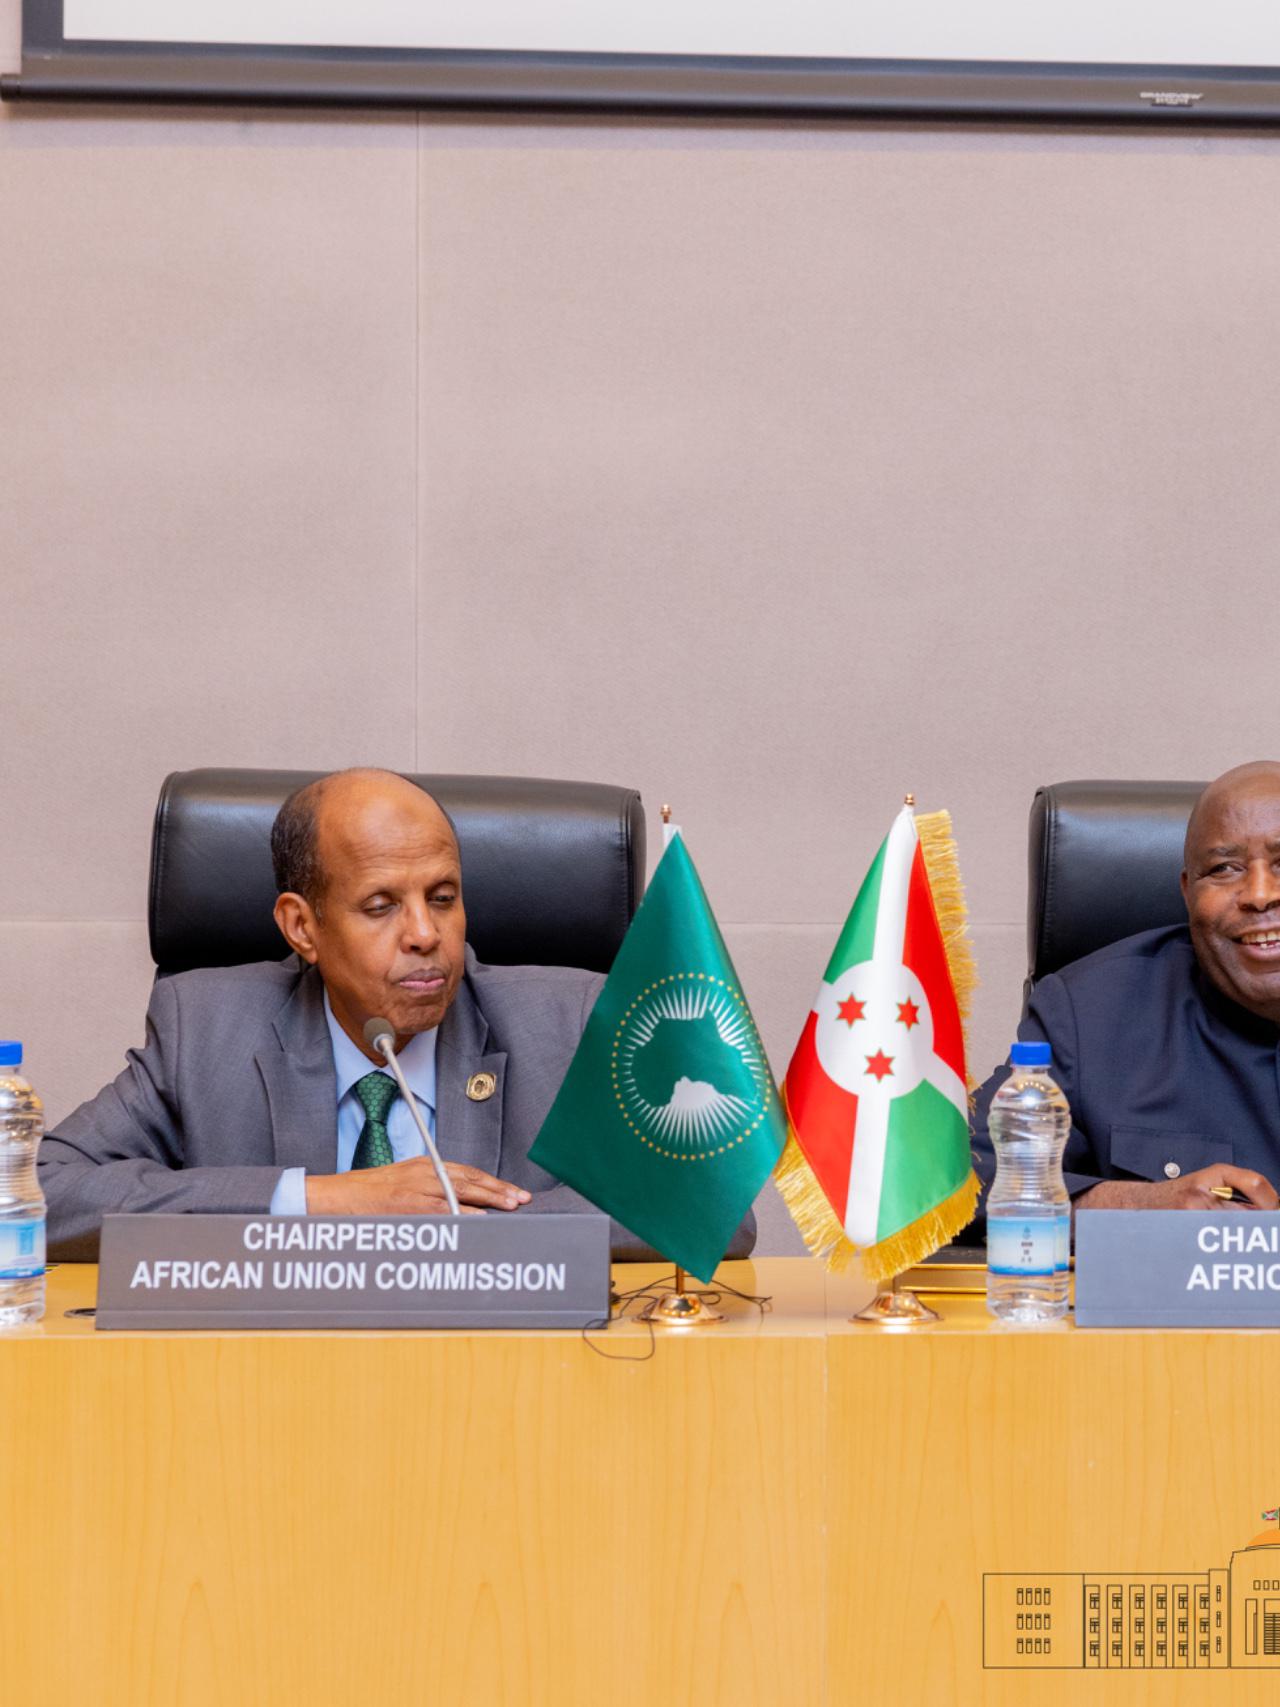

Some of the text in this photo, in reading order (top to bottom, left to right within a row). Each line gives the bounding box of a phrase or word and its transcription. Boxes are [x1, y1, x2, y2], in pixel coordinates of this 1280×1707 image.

[243, 1222, 459, 1251] CHAIRPERSON
[129, 1260, 566, 1291] AFRICAN UNION COMMISSION
